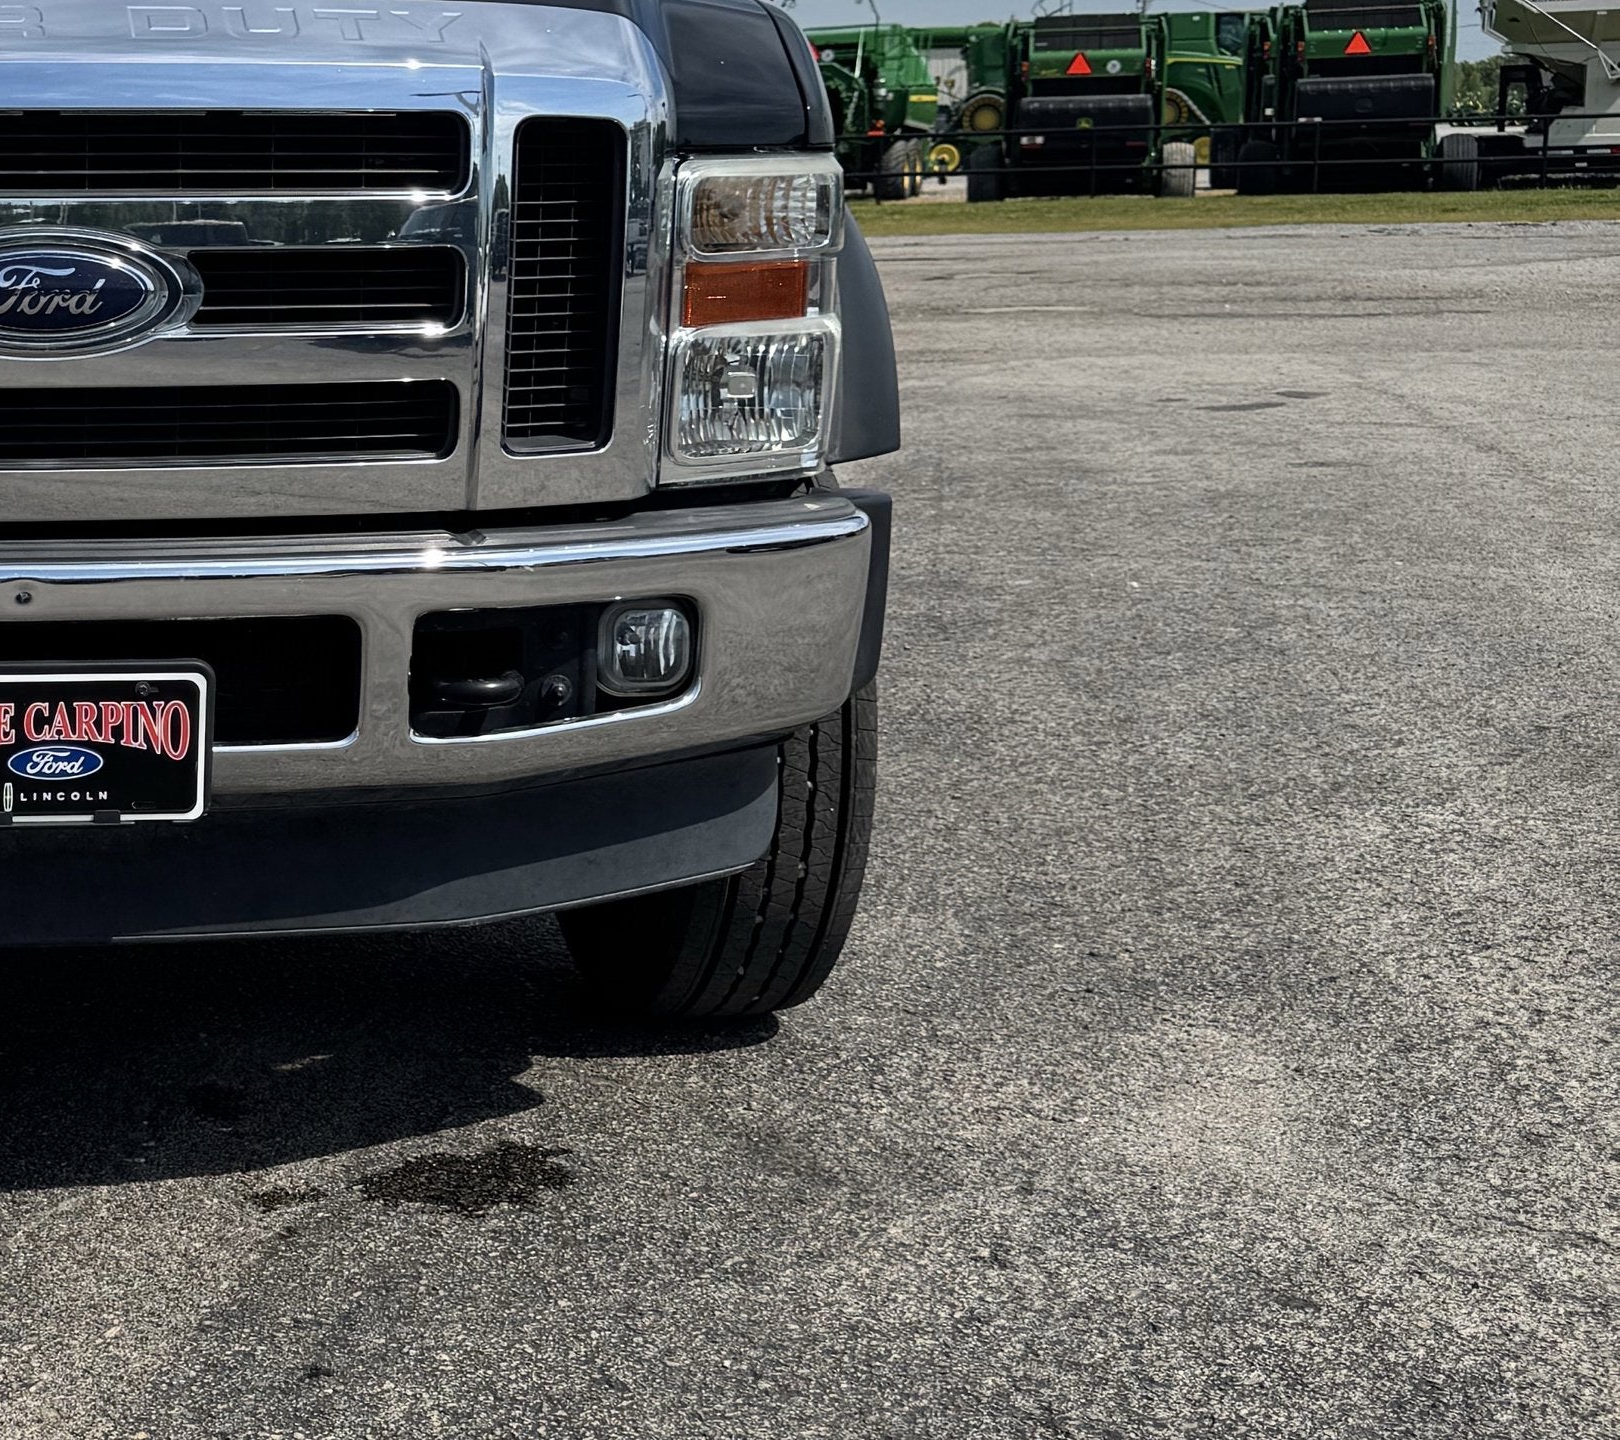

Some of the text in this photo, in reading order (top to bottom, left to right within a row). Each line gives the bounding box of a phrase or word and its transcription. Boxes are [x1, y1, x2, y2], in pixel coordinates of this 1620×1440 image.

[126, 5, 463, 43] DUTY
[24, 700, 190, 760] CARPINO
[26, 751, 84, 774] Ford
[20, 790, 108, 802] LINCOLN
